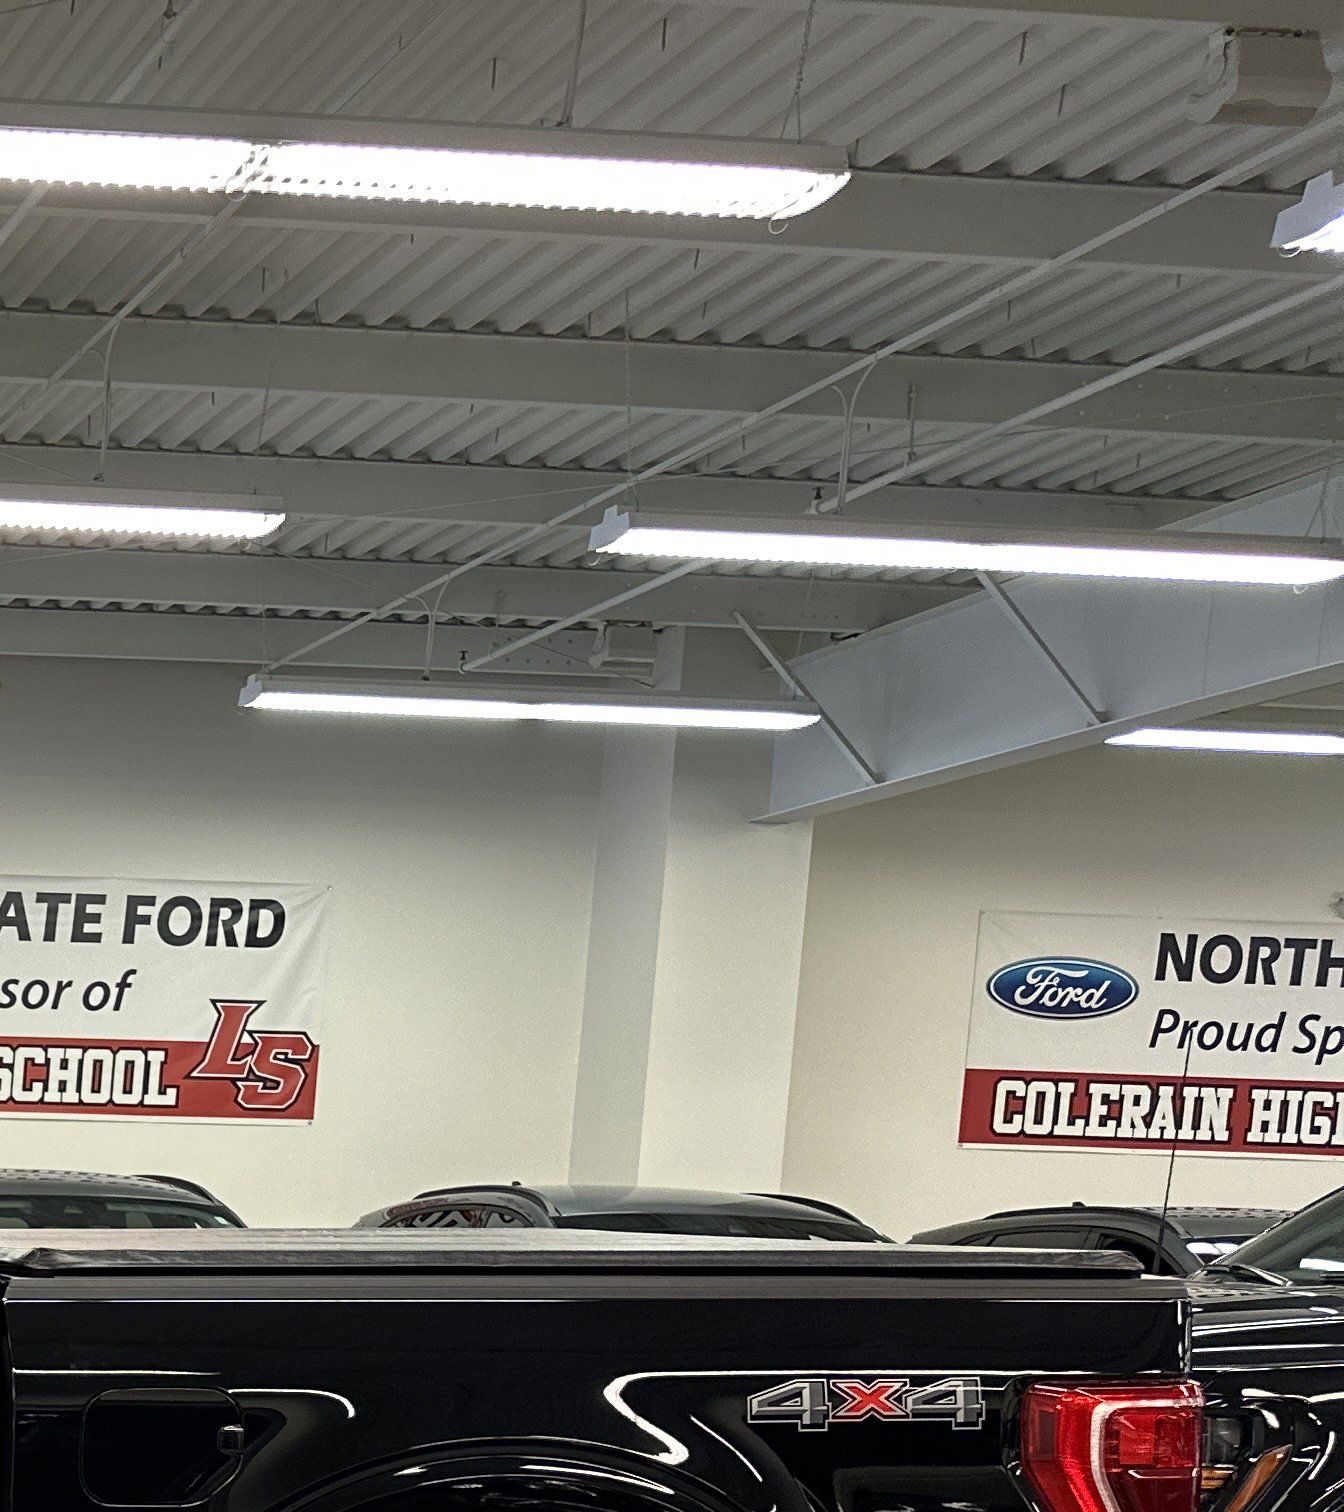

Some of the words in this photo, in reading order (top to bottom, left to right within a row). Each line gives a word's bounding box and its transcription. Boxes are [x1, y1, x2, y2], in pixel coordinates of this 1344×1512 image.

[120, 894, 286, 949] FORD
[1154, 932, 1344, 987] NORTH
[81, 969, 138, 1012] of
[1013, 965, 1111, 1011] Ford
[185, 998, 315, 1112] LS
[1148, 1007, 1287, 1055] Proud
[993, 1077, 1235, 1143] COLERAIN
